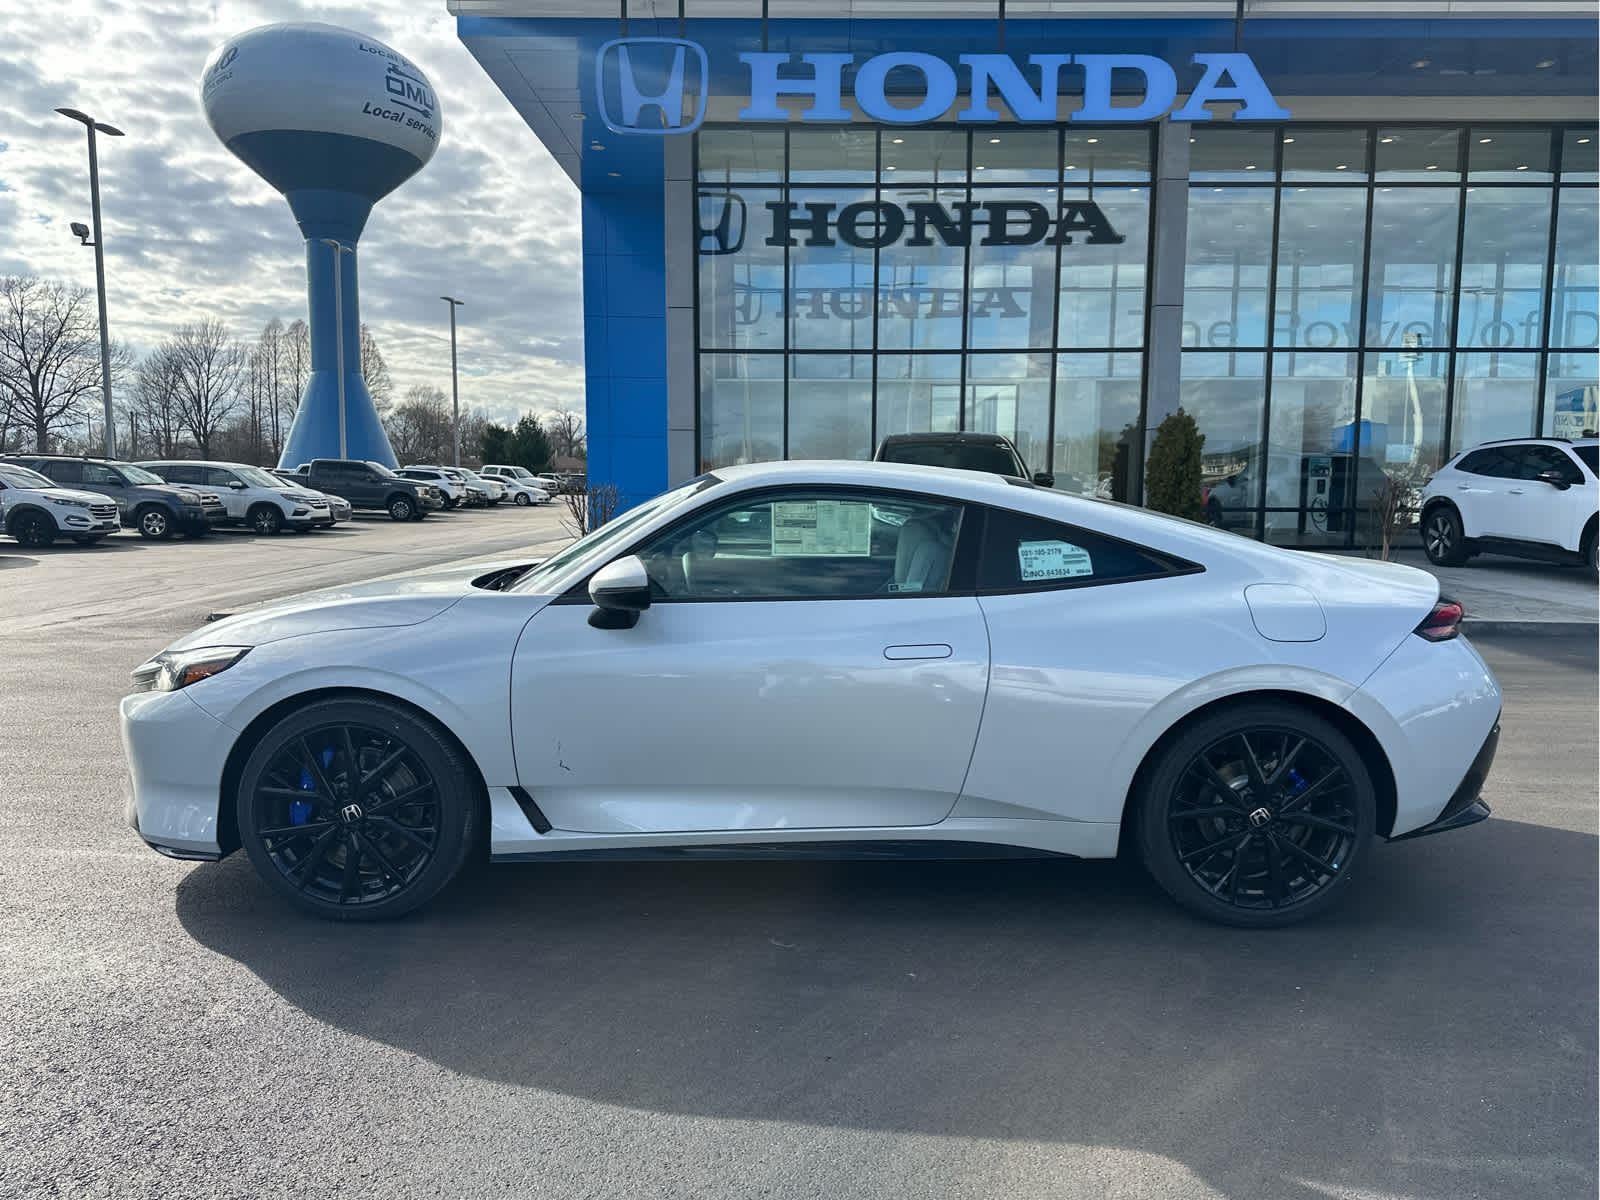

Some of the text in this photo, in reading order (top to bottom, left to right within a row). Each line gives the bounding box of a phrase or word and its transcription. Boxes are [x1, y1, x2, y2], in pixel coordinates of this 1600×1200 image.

[737, 51, 1291, 126] HONDA
[361, 100, 406, 123] Local
[765, 200, 1127, 248] HONDA
[775, 287, 1028, 319] HONDA
